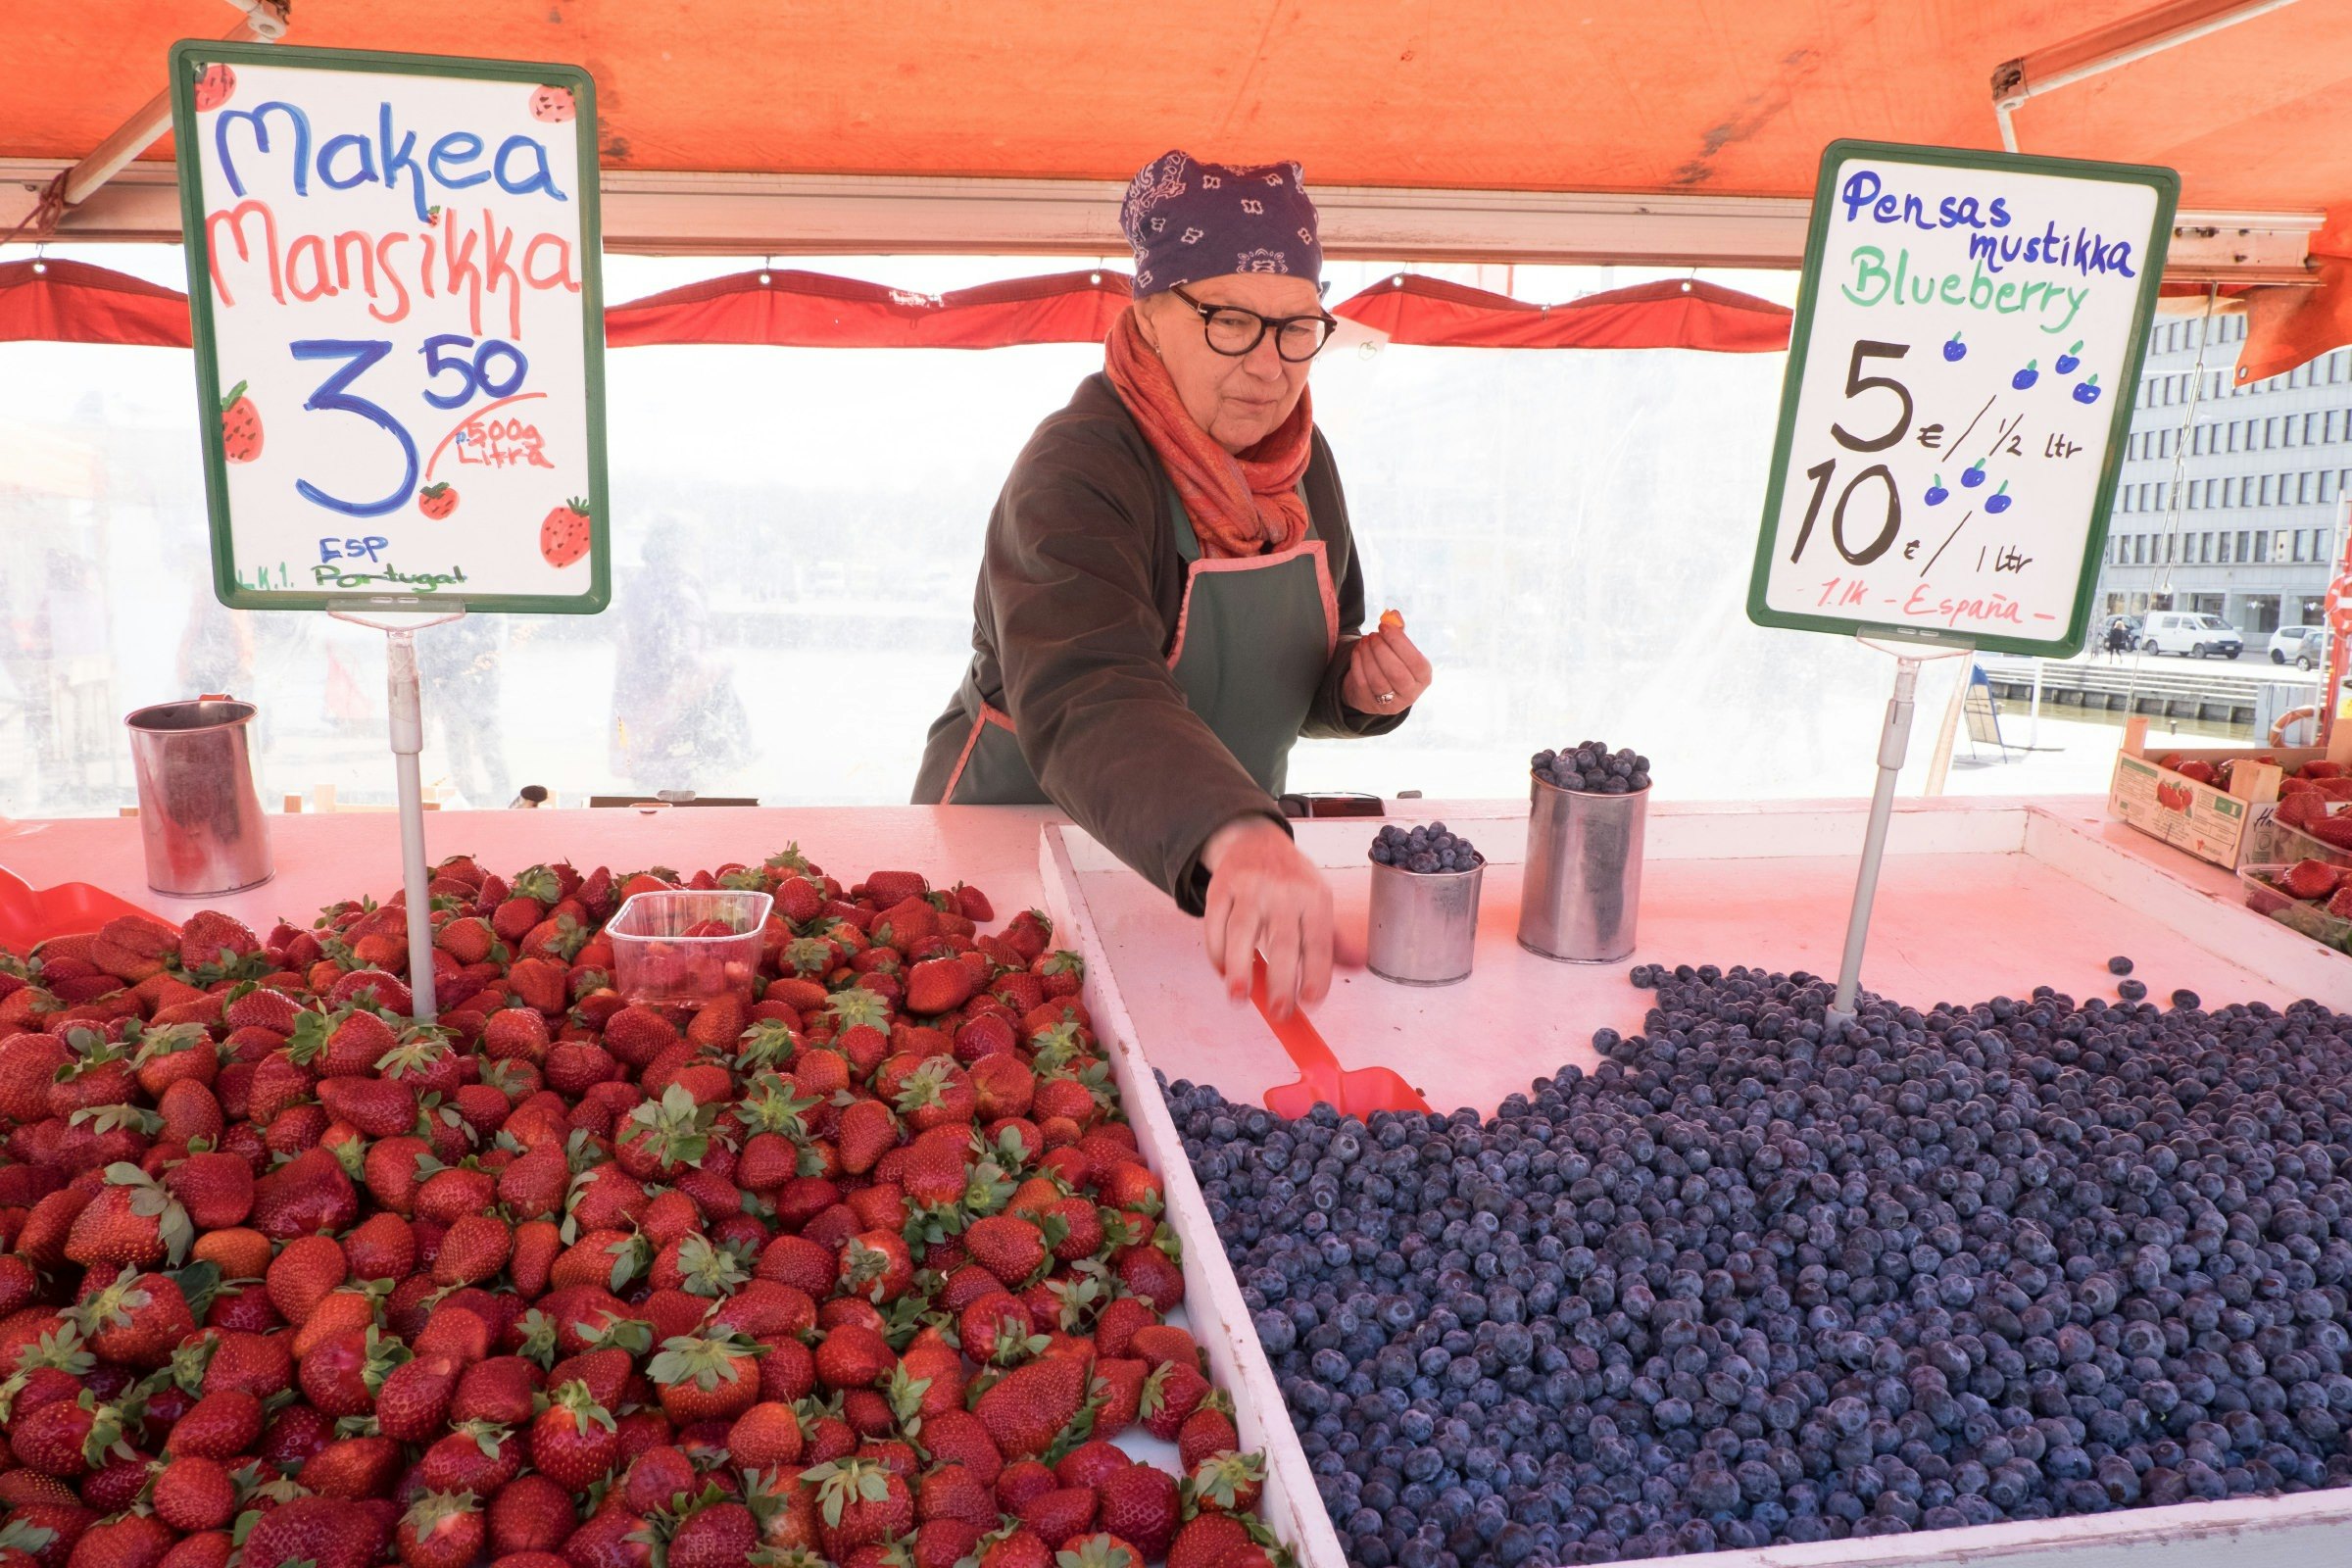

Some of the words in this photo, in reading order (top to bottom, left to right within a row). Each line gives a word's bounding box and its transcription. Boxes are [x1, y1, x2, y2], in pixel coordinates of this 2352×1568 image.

[216, 101, 568, 223] Makea
[1842, 171, 2012, 230] Pensas
[205, 199, 582, 341] Mansikka
[1969, 220, 2136, 278] mustikka
[1841, 245, 2089, 333] Blueberry
[289, 338, 420, 518] 3
[418, 333, 529, 410] 50
[311, 563, 468, 594] Portugal
[319, 536, 389, 564] ESP
